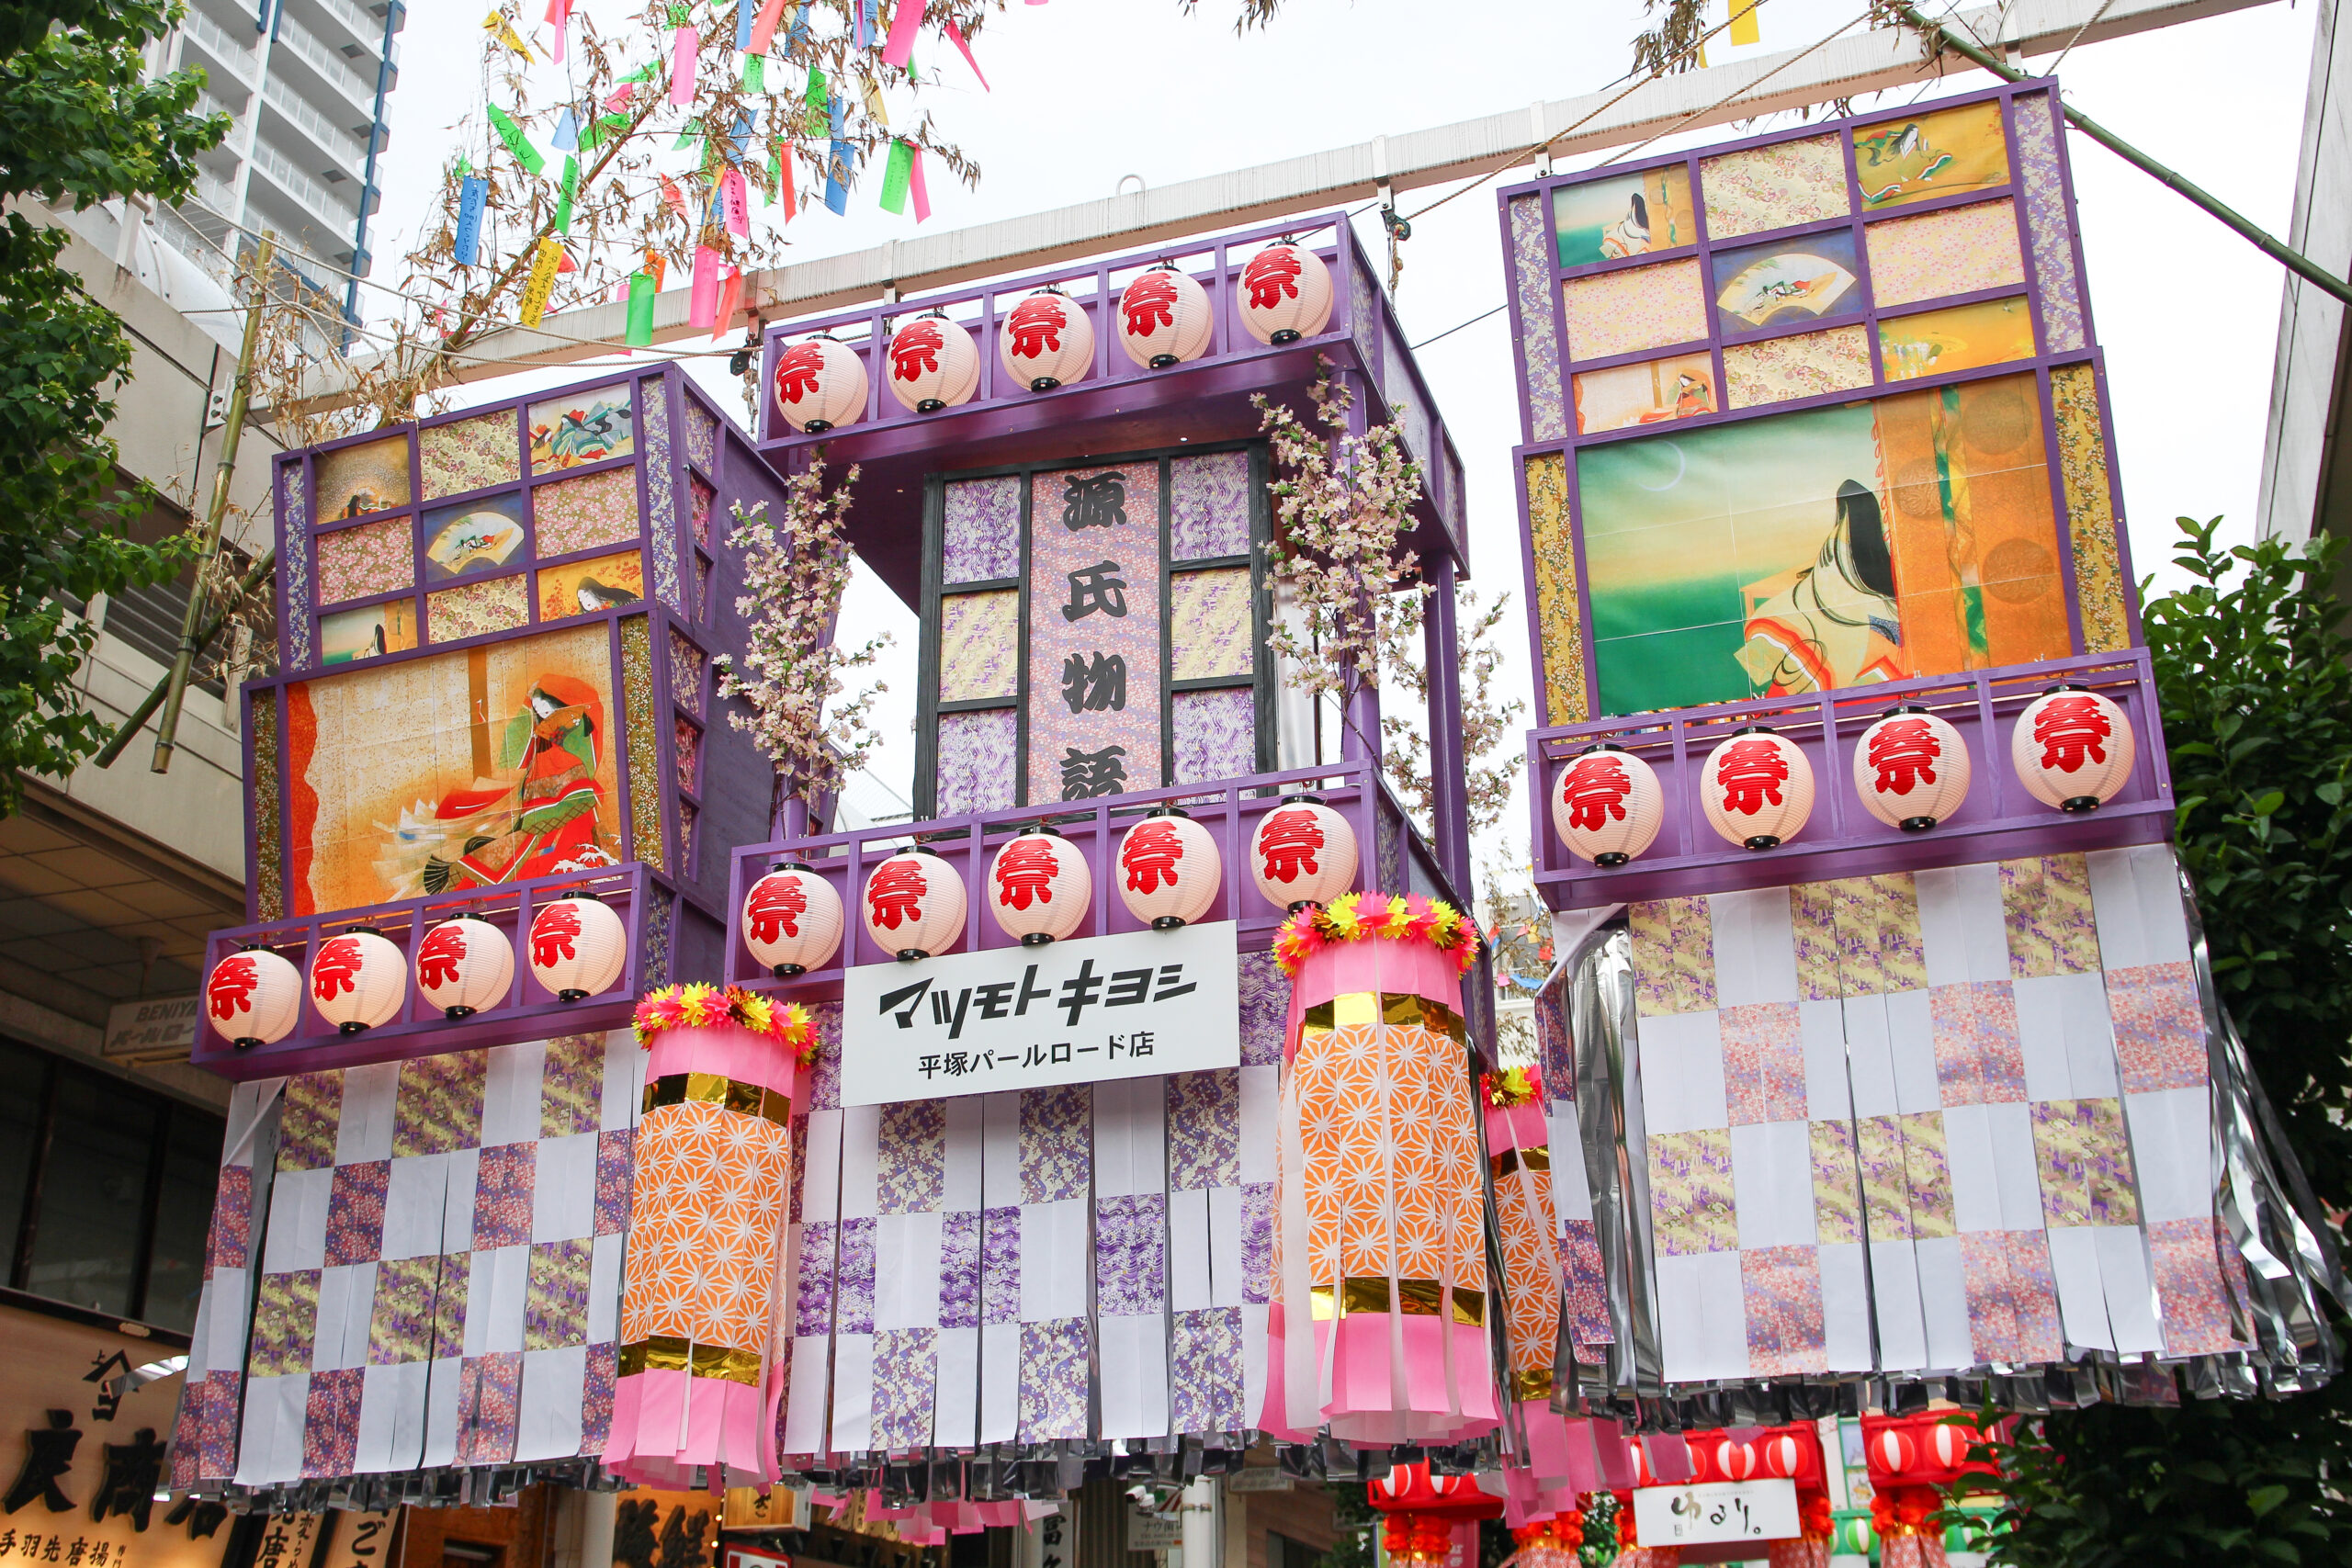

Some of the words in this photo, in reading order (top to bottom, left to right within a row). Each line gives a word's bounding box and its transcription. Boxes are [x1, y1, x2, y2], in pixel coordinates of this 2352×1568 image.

[1123, 271, 1179, 337] 祭
[1244, 243, 1302, 310] 祭
[890, 320, 944, 382] 祭
[1009, 296, 1068, 359] 祭
[775, 341, 825, 405] 祭
[1060, 470, 1129, 802] 源氏物語
[1869, 717, 1941, 795] 祭
[2033, 697, 2111, 773] 祭
[1564, 757, 1632, 832] 祭
[1717, 739, 1789, 816] 祭
[996, 839, 1059, 911] 祭
[1122, 821, 1184, 896] 祭
[1259, 810, 1325, 884] 祭
[748, 875, 807, 945] 祭
[868, 860, 928, 931] 祭
[312, 937, 363, 1002] 祭
[417, 925, 467, 991] 祭
[529, 903, 582, 968] 祭
[209, 956, 258, 1021] 祭
[879, 958, 1197, 1040] マツモトキヨシ
[918, 1031, 1155, 1080] 平塚パールロード店
